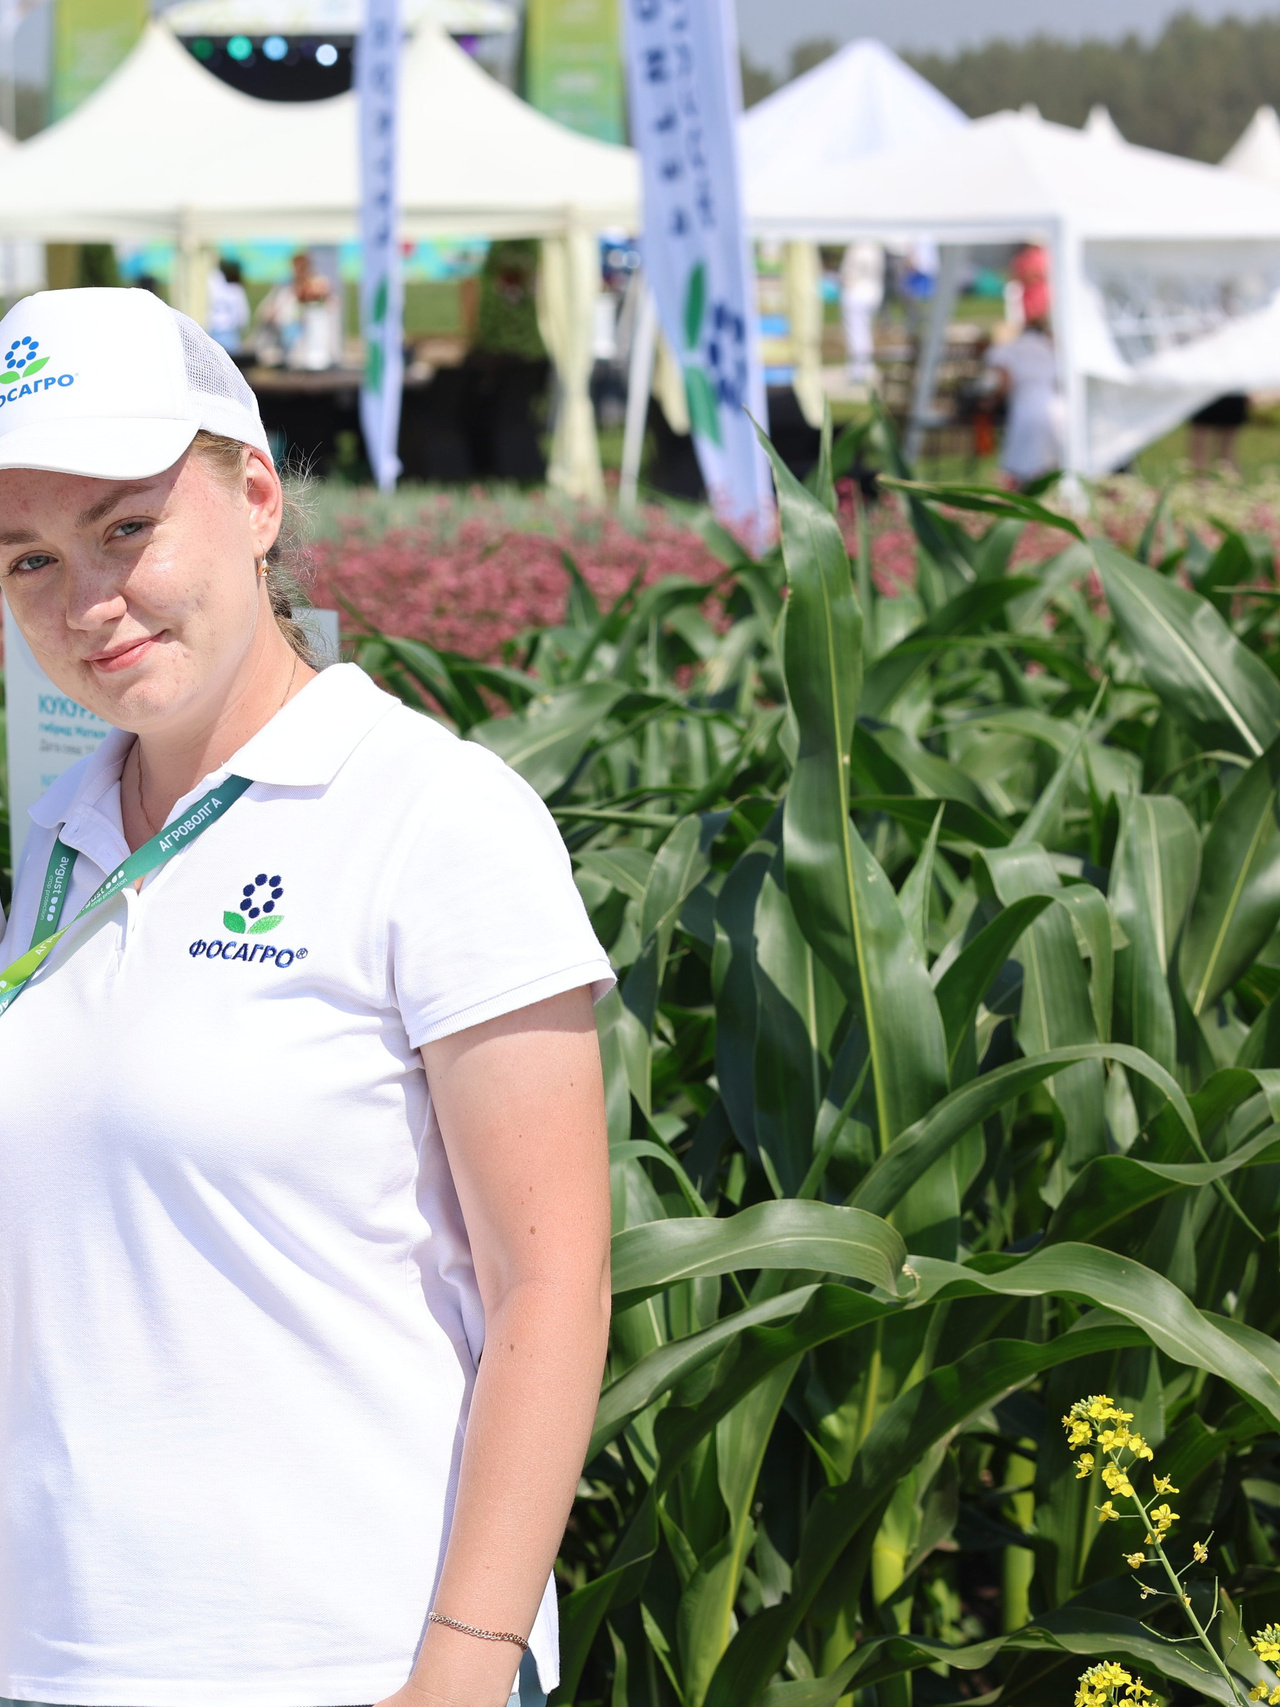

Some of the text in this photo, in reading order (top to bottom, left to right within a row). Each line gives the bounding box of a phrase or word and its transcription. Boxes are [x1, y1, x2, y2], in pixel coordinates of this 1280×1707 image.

[158, 797, 223, 852] АГРОВОЛГА
[53, 856, 70, 894] avgust
[41, 890, 51, 921] protection
